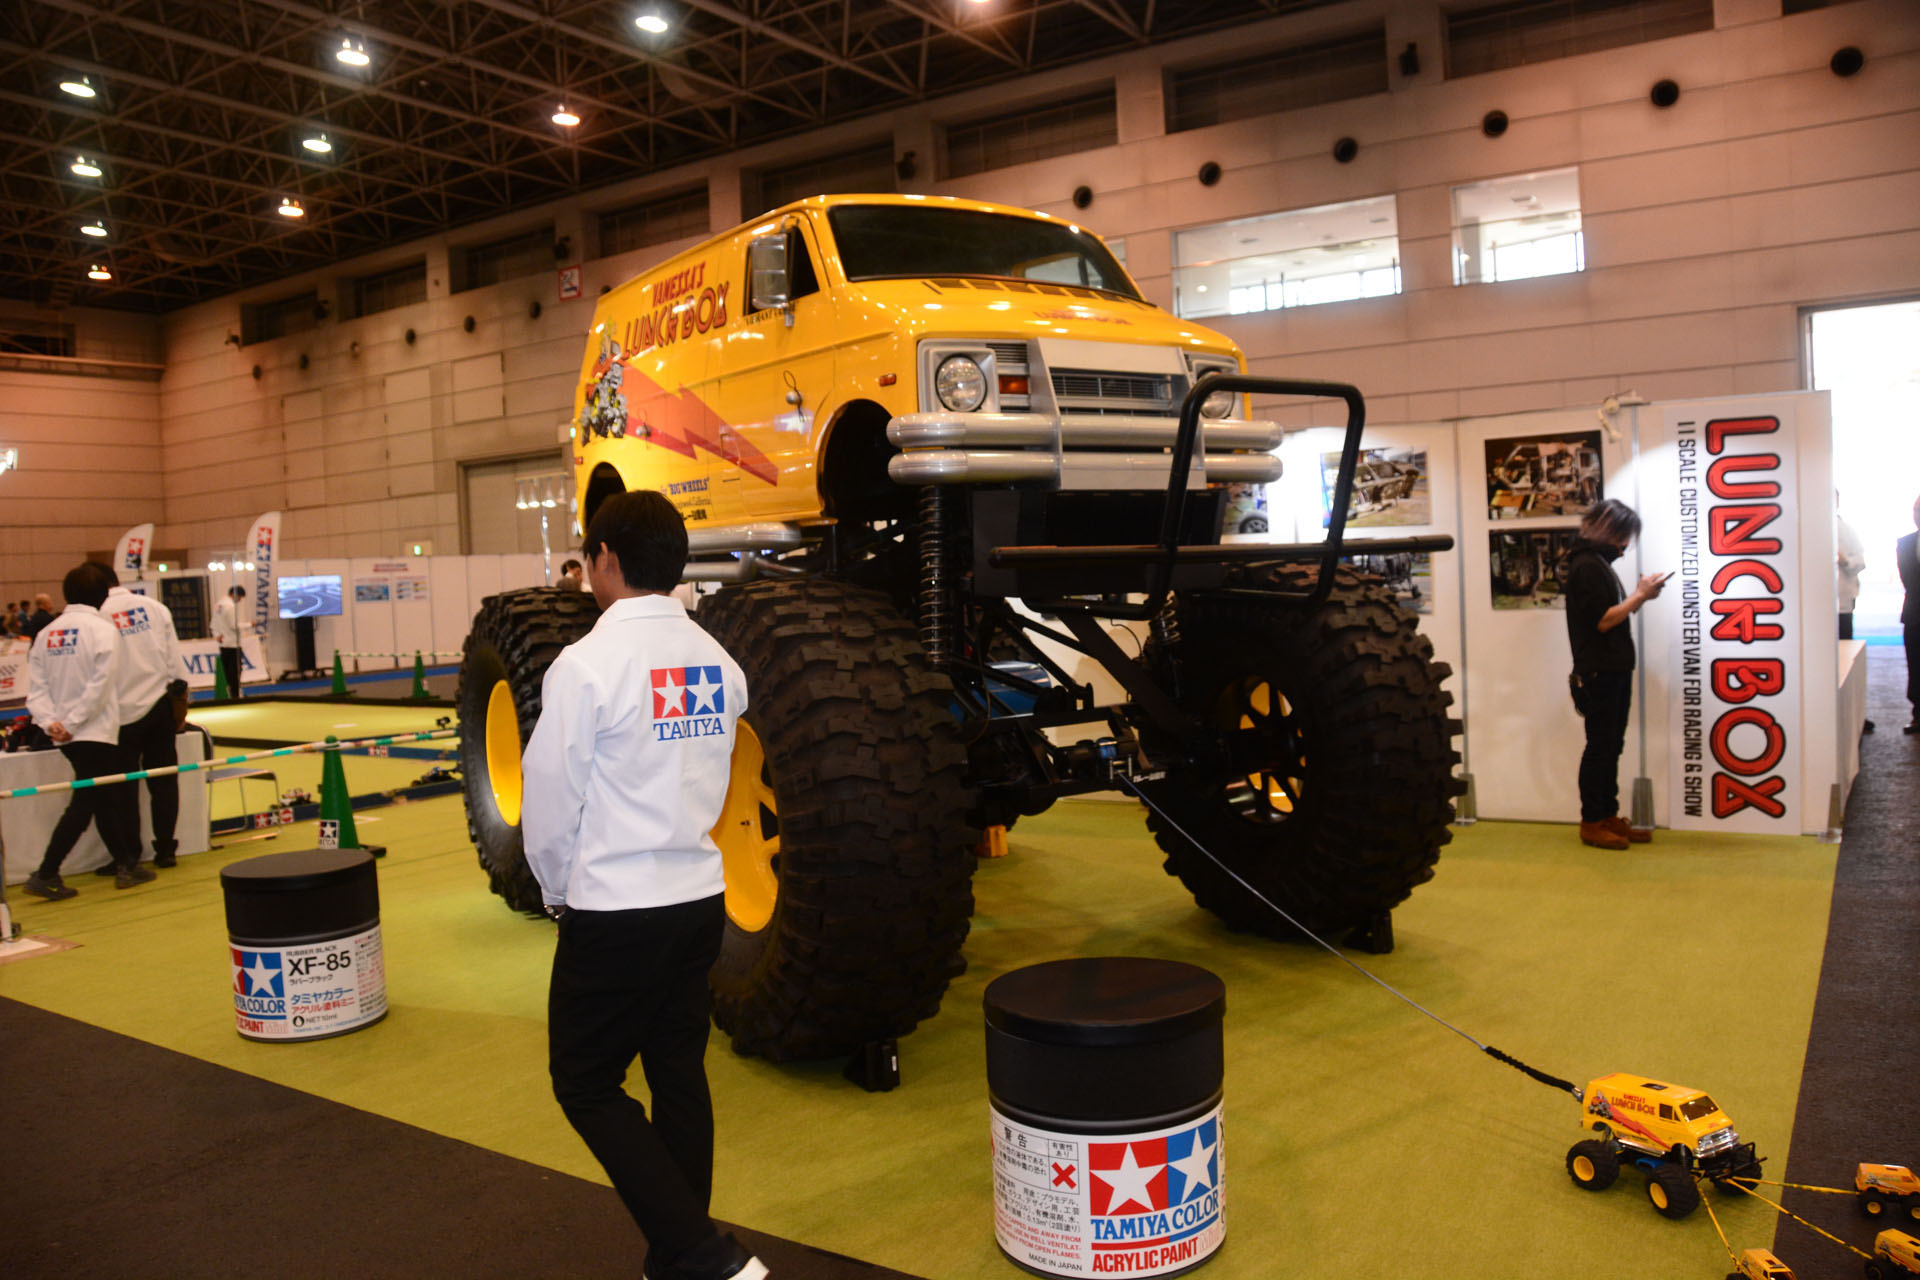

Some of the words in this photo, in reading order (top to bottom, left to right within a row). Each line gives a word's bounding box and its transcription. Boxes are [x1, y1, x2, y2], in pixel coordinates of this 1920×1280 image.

[621, 301, 680, 361] LUNCH
[681, 281, 730, 340] BOX
[1678, 439, 1697, 483] SCALE
[1680, 488, 1698, 576] CUSTOMIZED
[1705, 415, 1784, 644] LUNCH
[1682, 579, 1701, 645] MONSTER
[1683, 649, 1701, 675] VAN
[1683, 679, 1702, 705] FOR
[653, 717, 726, 741] TAMIYA
[1684, 708, 1702, 760] RACING
[1709, 657, 1786, 819] BOX
[1684, 776, 1702, 817] SHOW
[316, 945, 337, 953] BLACK
[288, 950, 351, 977] XF-85
[247, 998, 287, 1013] COLOR
[292, 987, 354, 1005] タミヤカラー
[292, 997, 355, 1014] アクリル塗料ミニ
[1090, 1213, 1170, 1240] TAMIYA
[1172, 1189, 1219, 1230] COLOR
[1028, 1225, 1040, 1235] AND
[1041, 1230, 1059, 1240] AWAY
[1061, 1234, 1082, 1243] FROM
[1030, 1234, 1045, 1246] WELL
[1019, 1237, 1034, 1248] FROM
[1034, 1244, 1052, 1254] OPEN
[1052, 1249, 1082, 1259] FLAMES.
[1092, 1249, 1159, 1273] ACRYLIC
[1160, 1236, 1198, 1266] PAINT
[1029, 1252, 1047, 1264] MADE
[1048, 1259, 1056, 1267] IN
[1057, 1260, 1082, 1271] JAPAN
